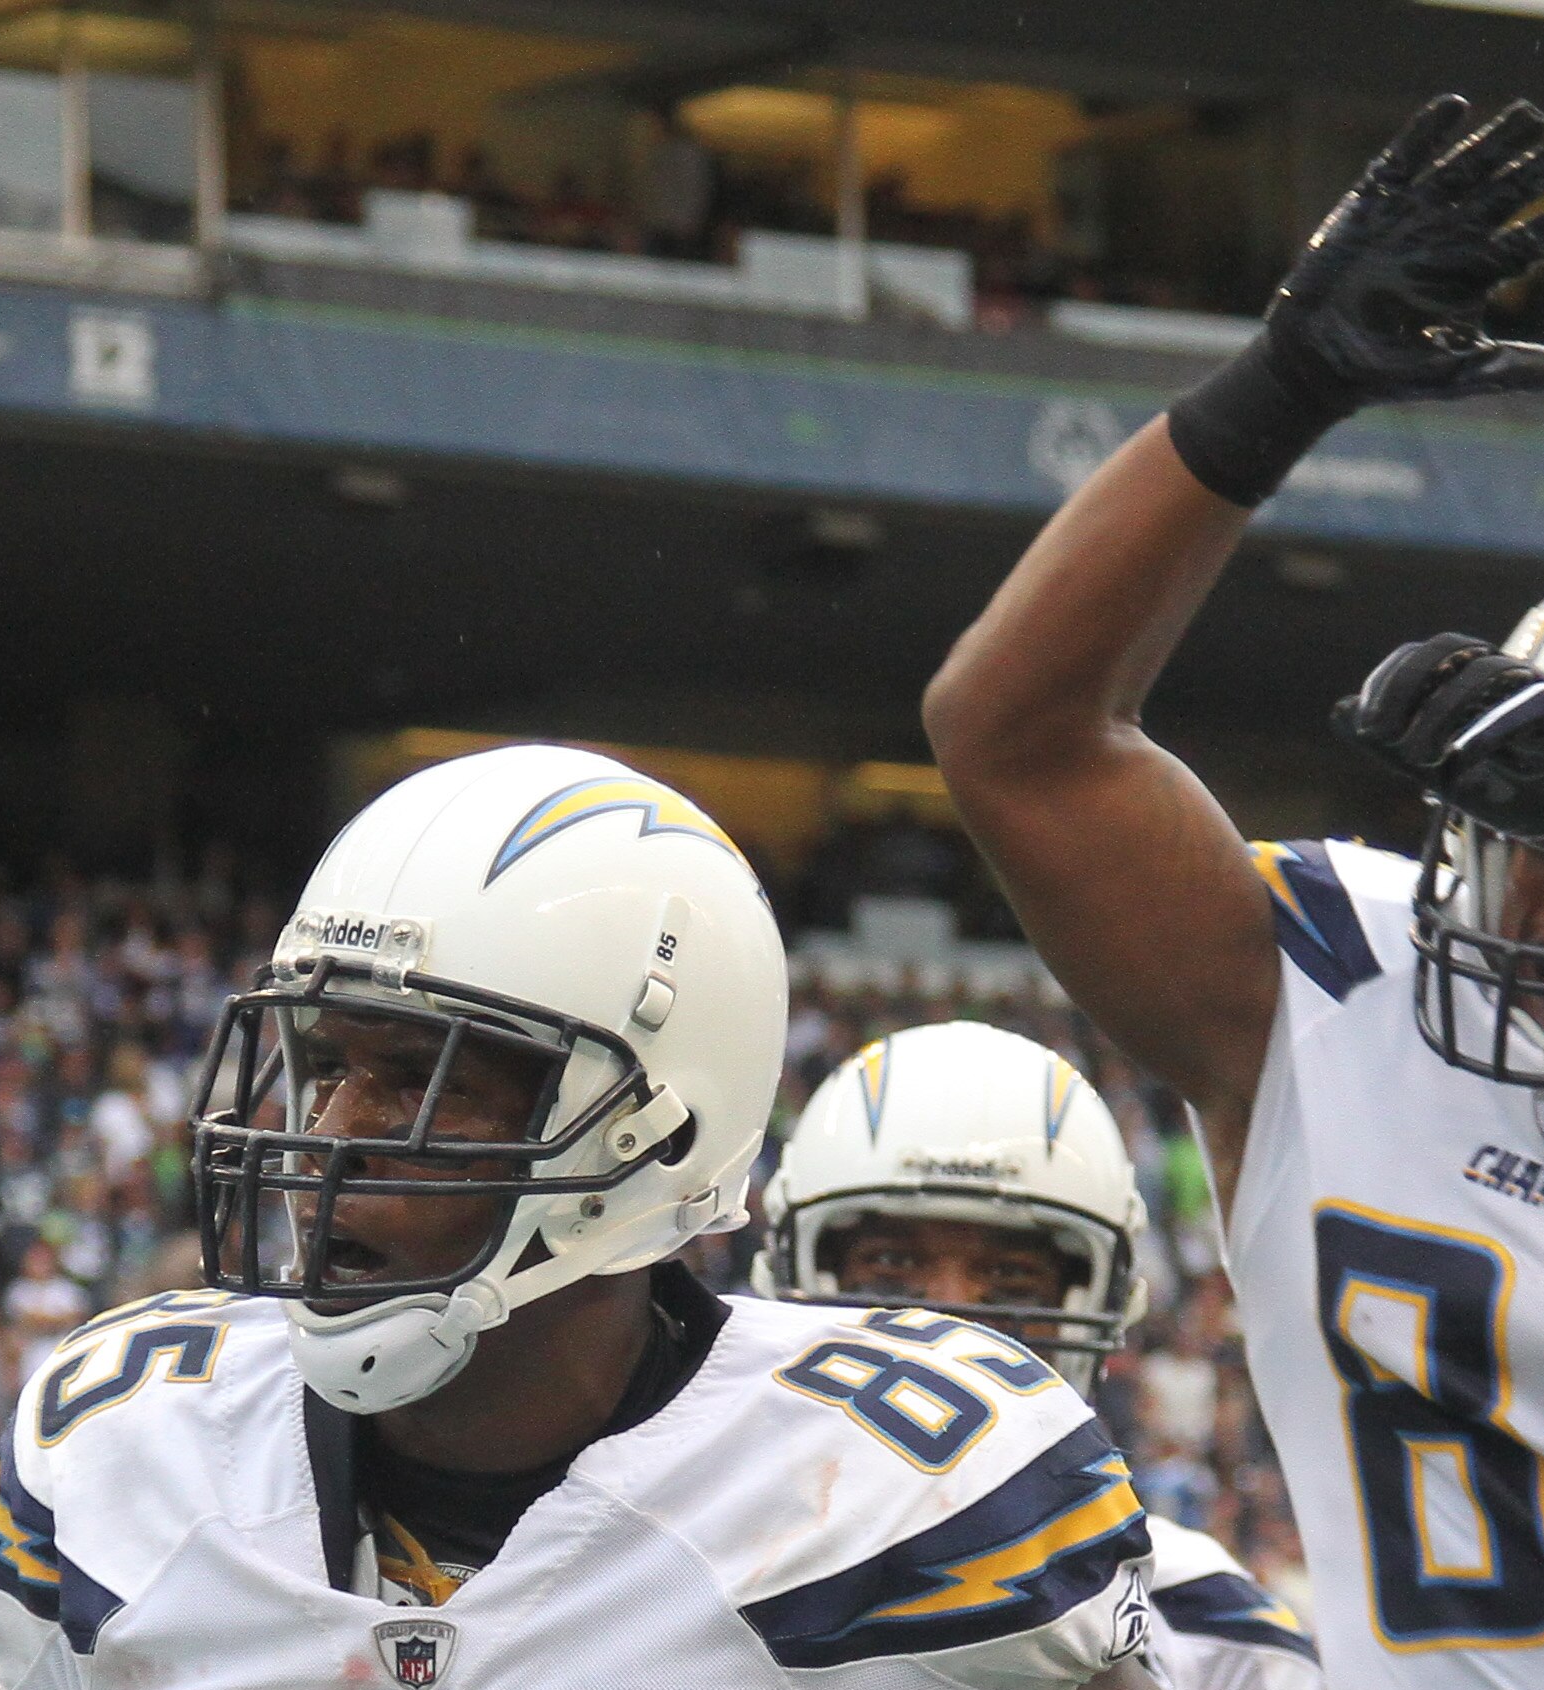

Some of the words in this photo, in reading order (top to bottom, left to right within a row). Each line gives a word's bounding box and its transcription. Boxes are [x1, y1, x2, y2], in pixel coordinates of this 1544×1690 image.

[656, 931, 677, 962] 85
[771, 1307, 1064, 1475] 85
[377, 1623, 453, 1641] EQUIPMENT
[398, 1657, 435, 1683] NFL
